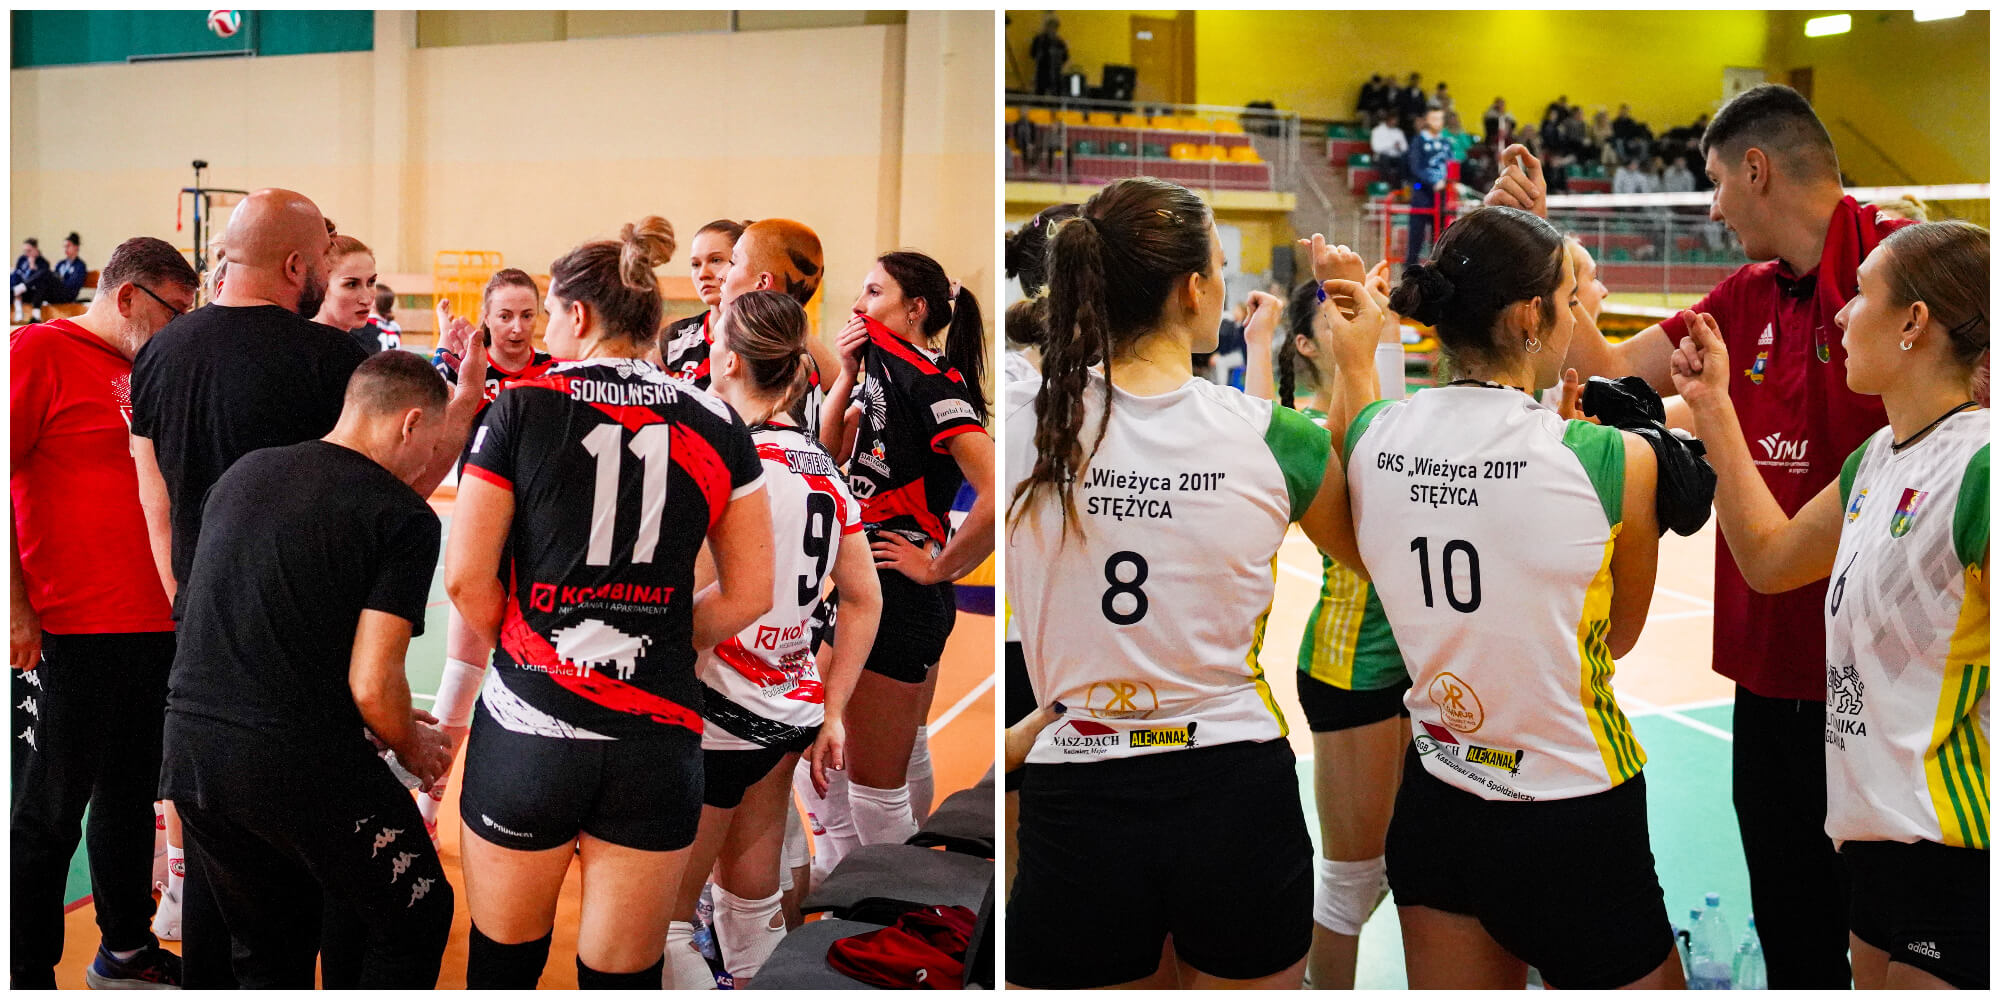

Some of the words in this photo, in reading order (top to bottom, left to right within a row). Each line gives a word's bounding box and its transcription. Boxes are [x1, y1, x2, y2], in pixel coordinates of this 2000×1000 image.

[1772, 439, 1809, 460] SMS
[1083, 467, 1171, 495] „Wieżyca
[1377, 451, 1405, 473] GKS
[1407, 456, 1477, 482] „Wieżyca
[580, 422, 670, 567] 11
[1087, 494, 1173, 521] STĘŻYCA
[1410, 482, 1479, 509] STĘŻYCA
[798, 492, 836, 607] 9
[1101, 550, 1149, 626] 8
[1410, 536, 1482, 614] 10
[1830, 551, 1858, 617] 6
[1435, 752, 1469, 776] Kaszubski
[1468, 772, 1487, 785] Bank
[1907, 941, 1941, 959] adidas
